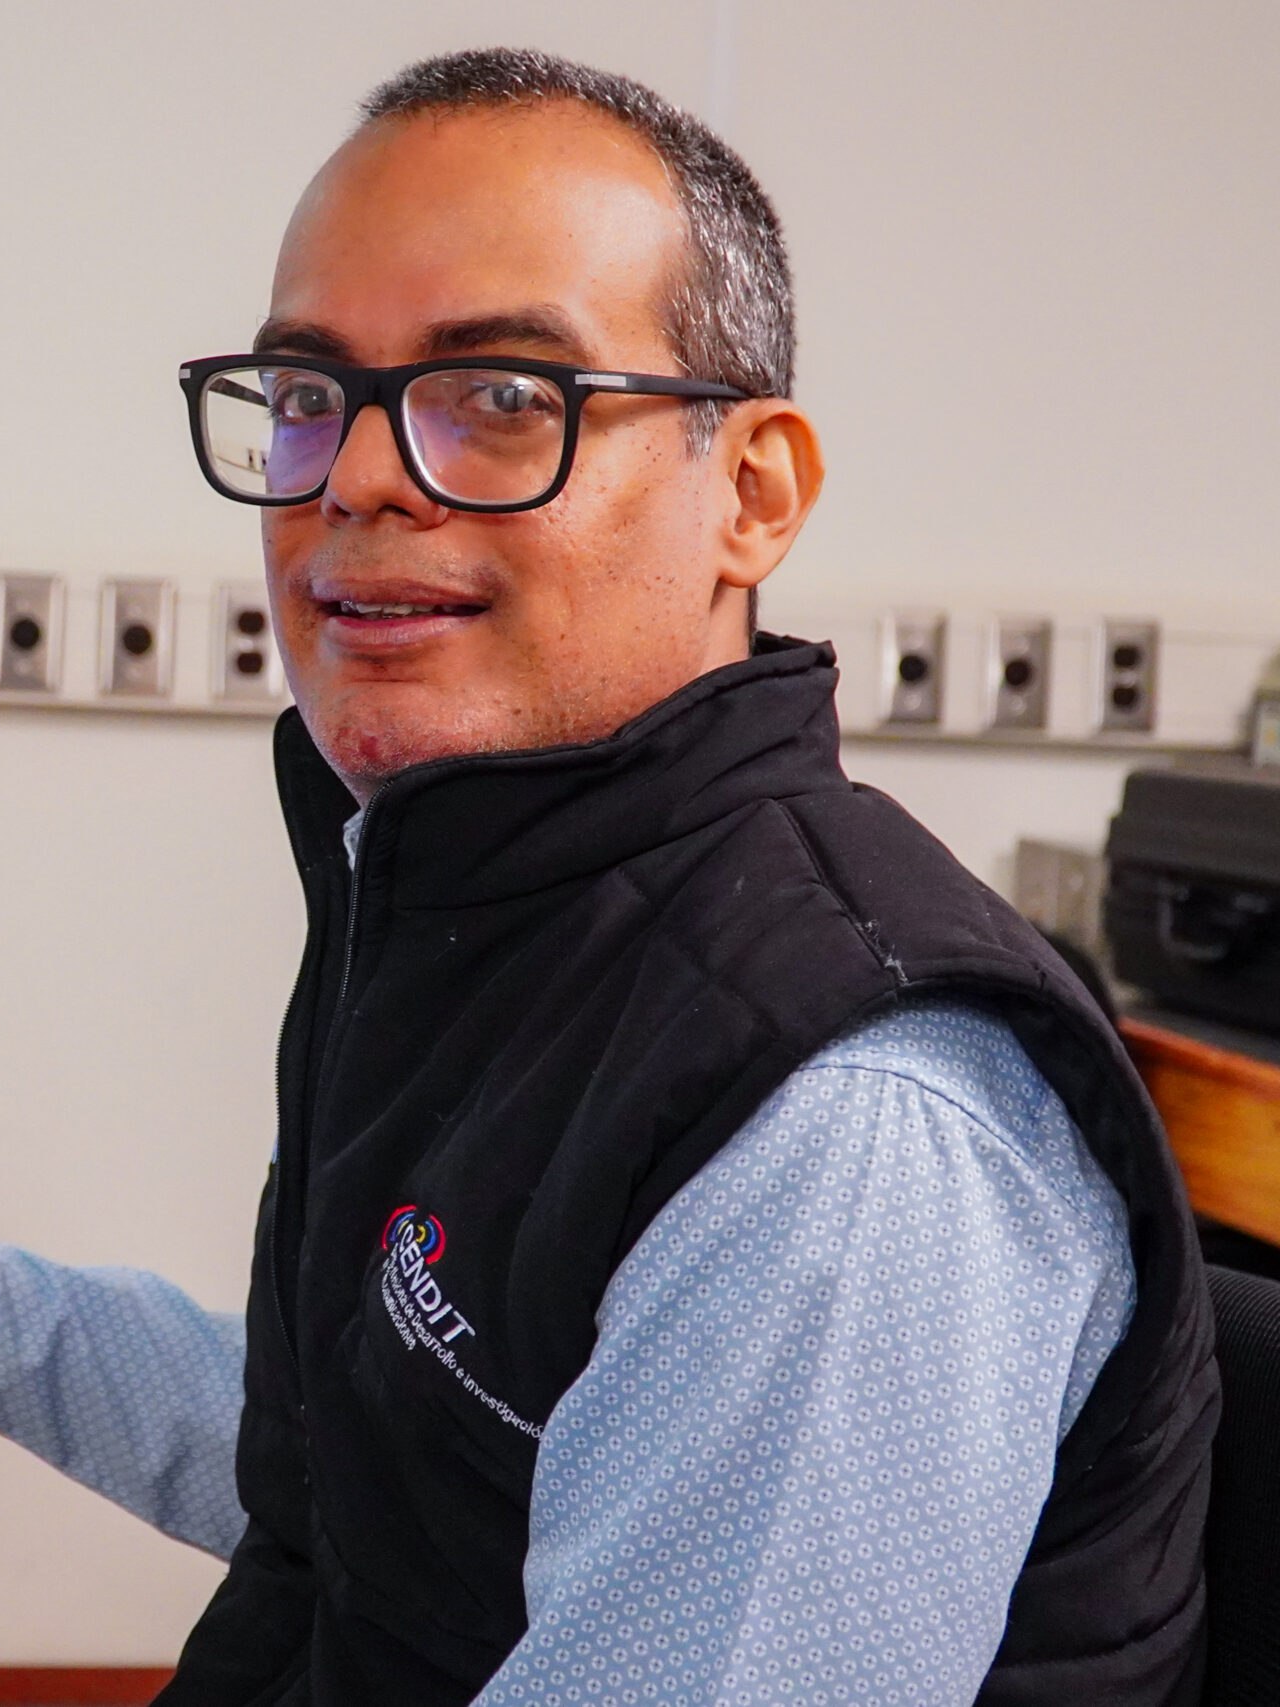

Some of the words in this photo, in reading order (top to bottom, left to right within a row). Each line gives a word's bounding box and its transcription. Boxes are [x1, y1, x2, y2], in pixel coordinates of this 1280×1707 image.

[399, 1223, 476, 1343] CENDIT
[404, 1303, 415, 1318] de
[411, 1312, 457, 1369] Desarrollo
[455, 1367, 465, 1379] e
[462, 1373, 543, 1439] investigació
